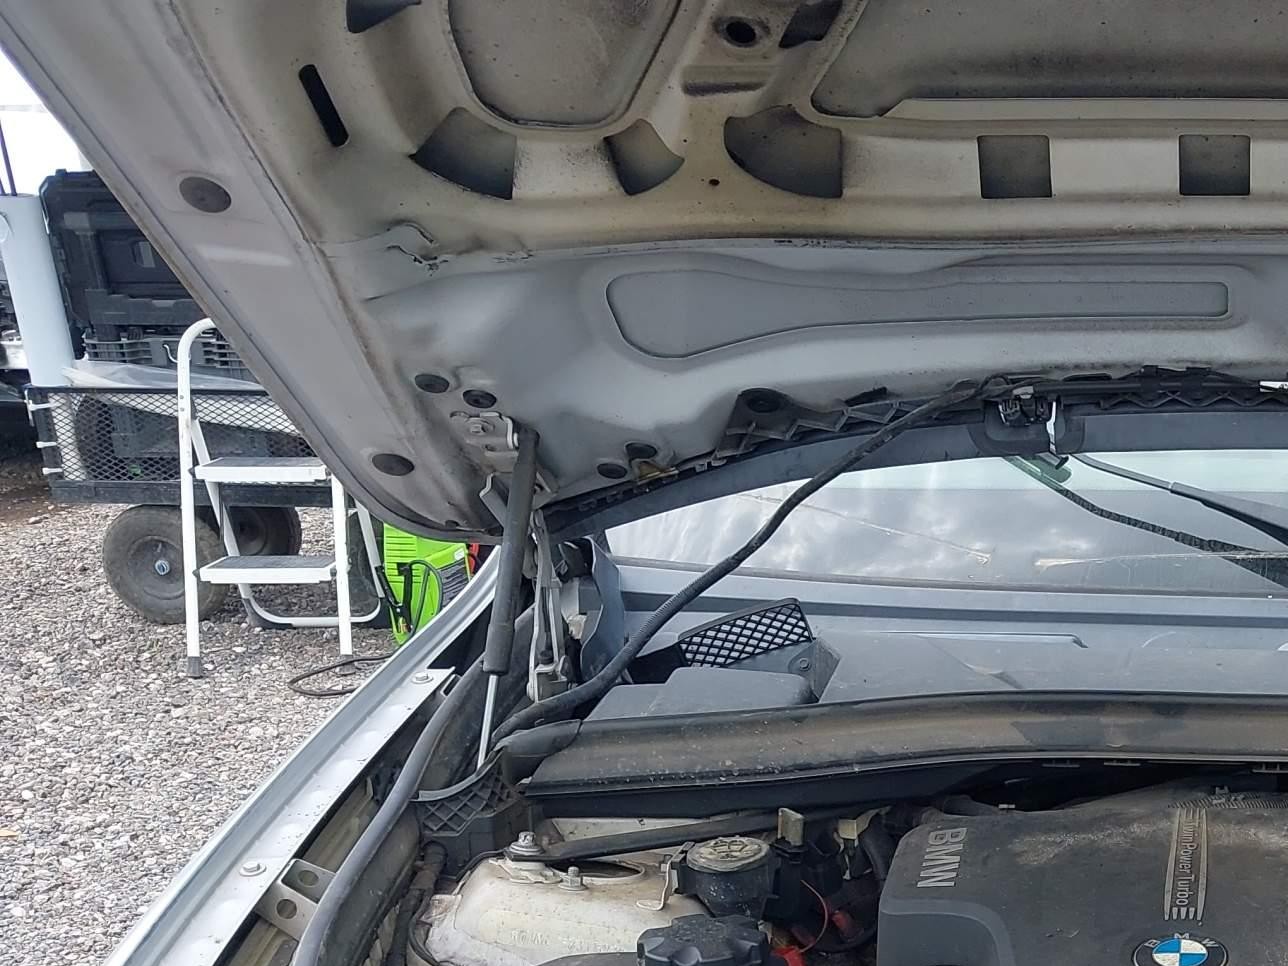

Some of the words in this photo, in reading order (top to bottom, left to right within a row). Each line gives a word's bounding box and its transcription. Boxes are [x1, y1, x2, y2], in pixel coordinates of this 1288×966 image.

[917, 827, 967, 887] BMW
[1178, 817, 1199, 874] TwinPower
[1175, 874, 1196, 906] Turbo
[1144, 932, 1220, 949] BMW
